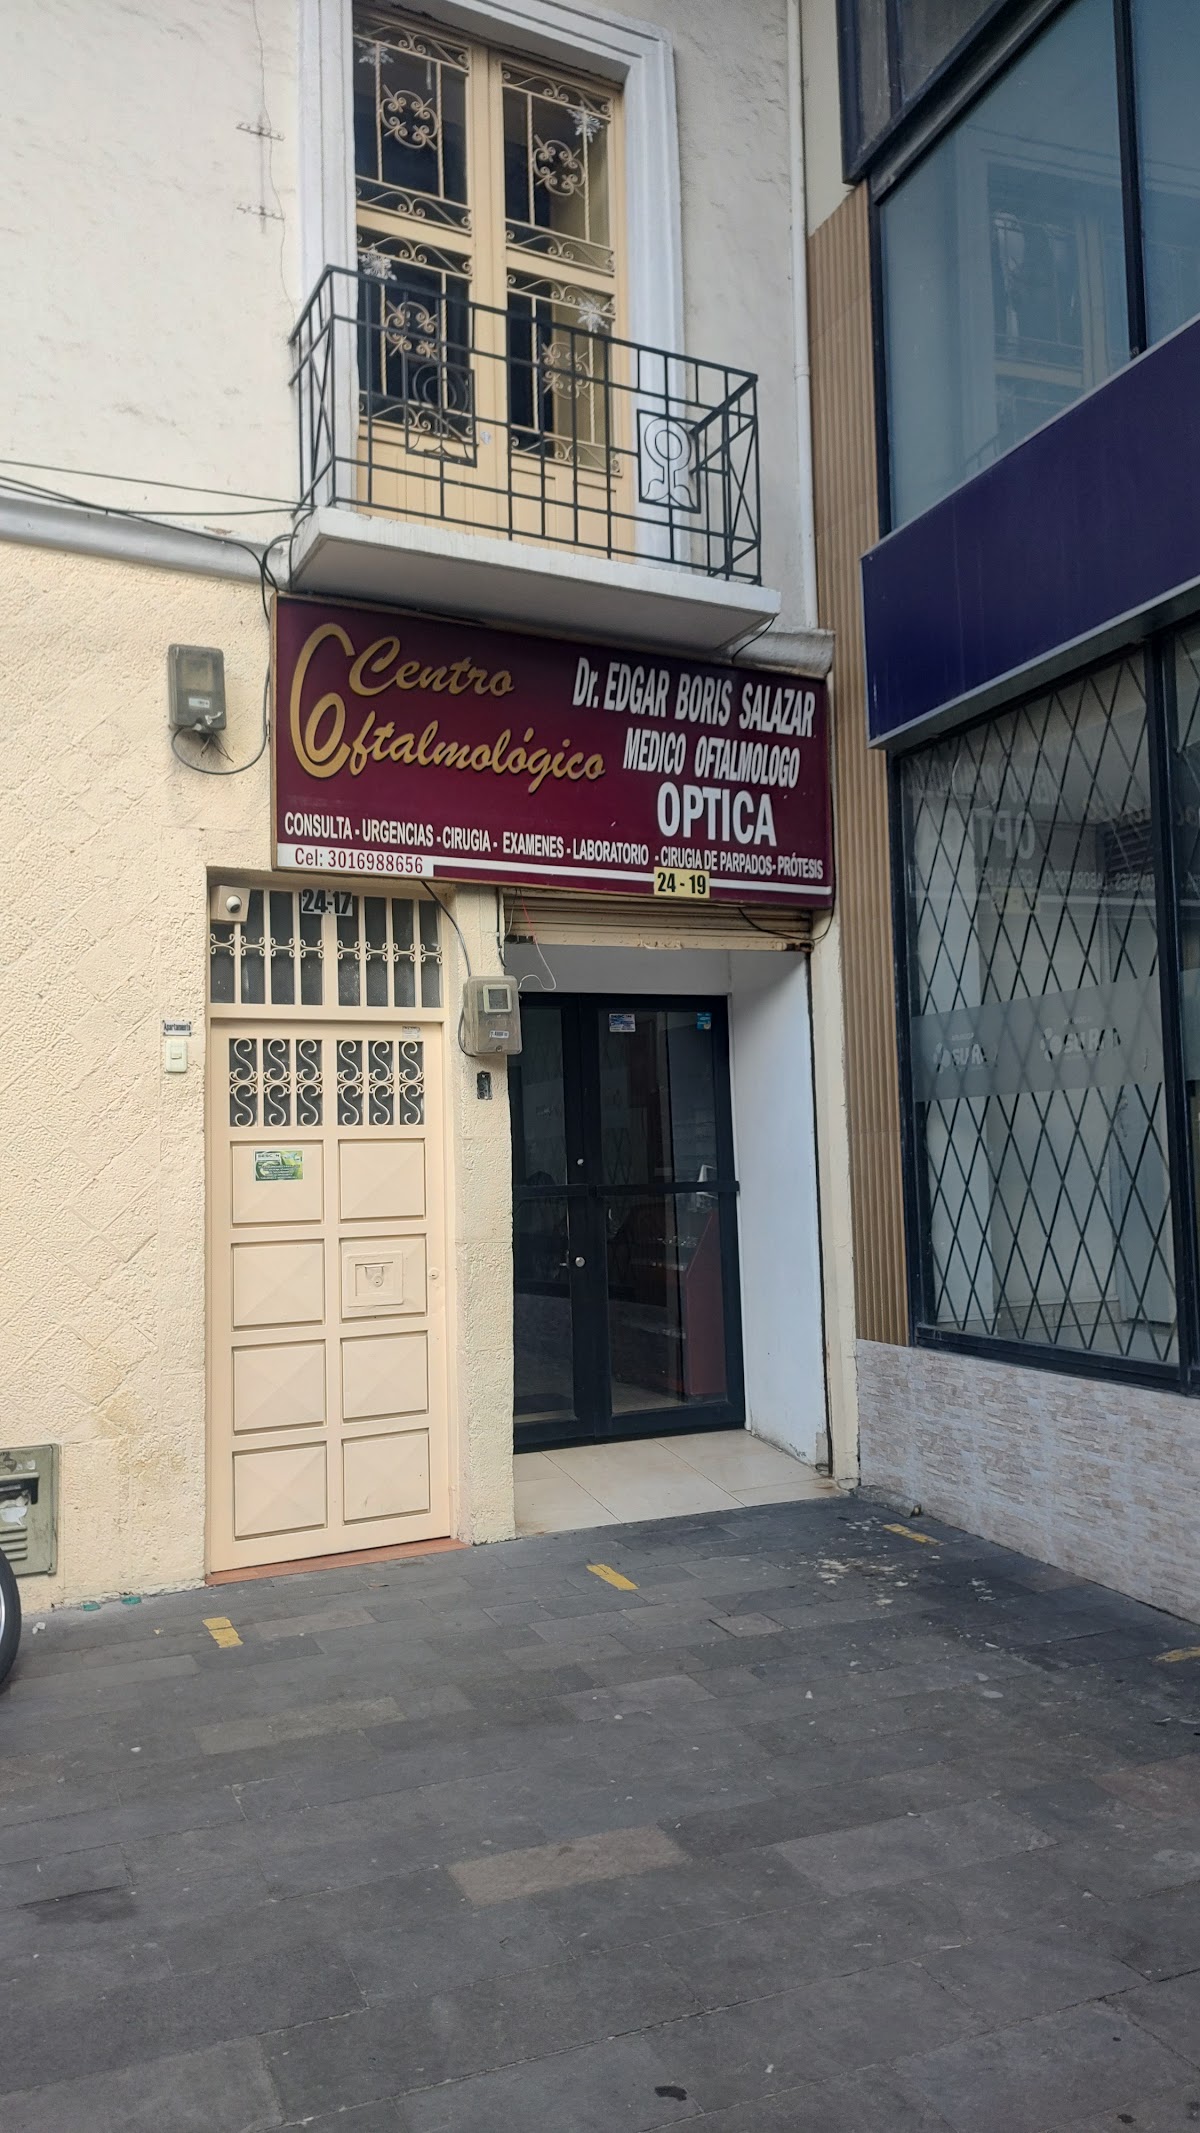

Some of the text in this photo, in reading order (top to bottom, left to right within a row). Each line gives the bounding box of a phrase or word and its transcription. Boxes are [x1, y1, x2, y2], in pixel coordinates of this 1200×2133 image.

[349, 636, 515, 696] Centro
[572, 657, 816, 738] Dr. EDGAR BORIS SALAZAR
[623, 727, 801, 788] MEDICO OFTALMOLOGO
[657, 781, 777, 847] OPTICA
[285, 812, 352, 840] CONSULTA
[362, 818, 434, 847] URGENCIAS
[443, 826, 492, 852] CIRUGIA
[503, 831, 564, 858] EXAMENES
[573, 838, 649, 865] LABORATORIO
[661, 846, 703, 869] CIRUGIA
[704, 850, 718, 870] DE
[778, 852, 823, 880] PRÓTESIS
[295, 847, 423, 874] Cel: 3016988656
[302, 889, 352, 915] 24-17
[657, 872, 676, 892] 24
[689, 874, 706, 895] 19
